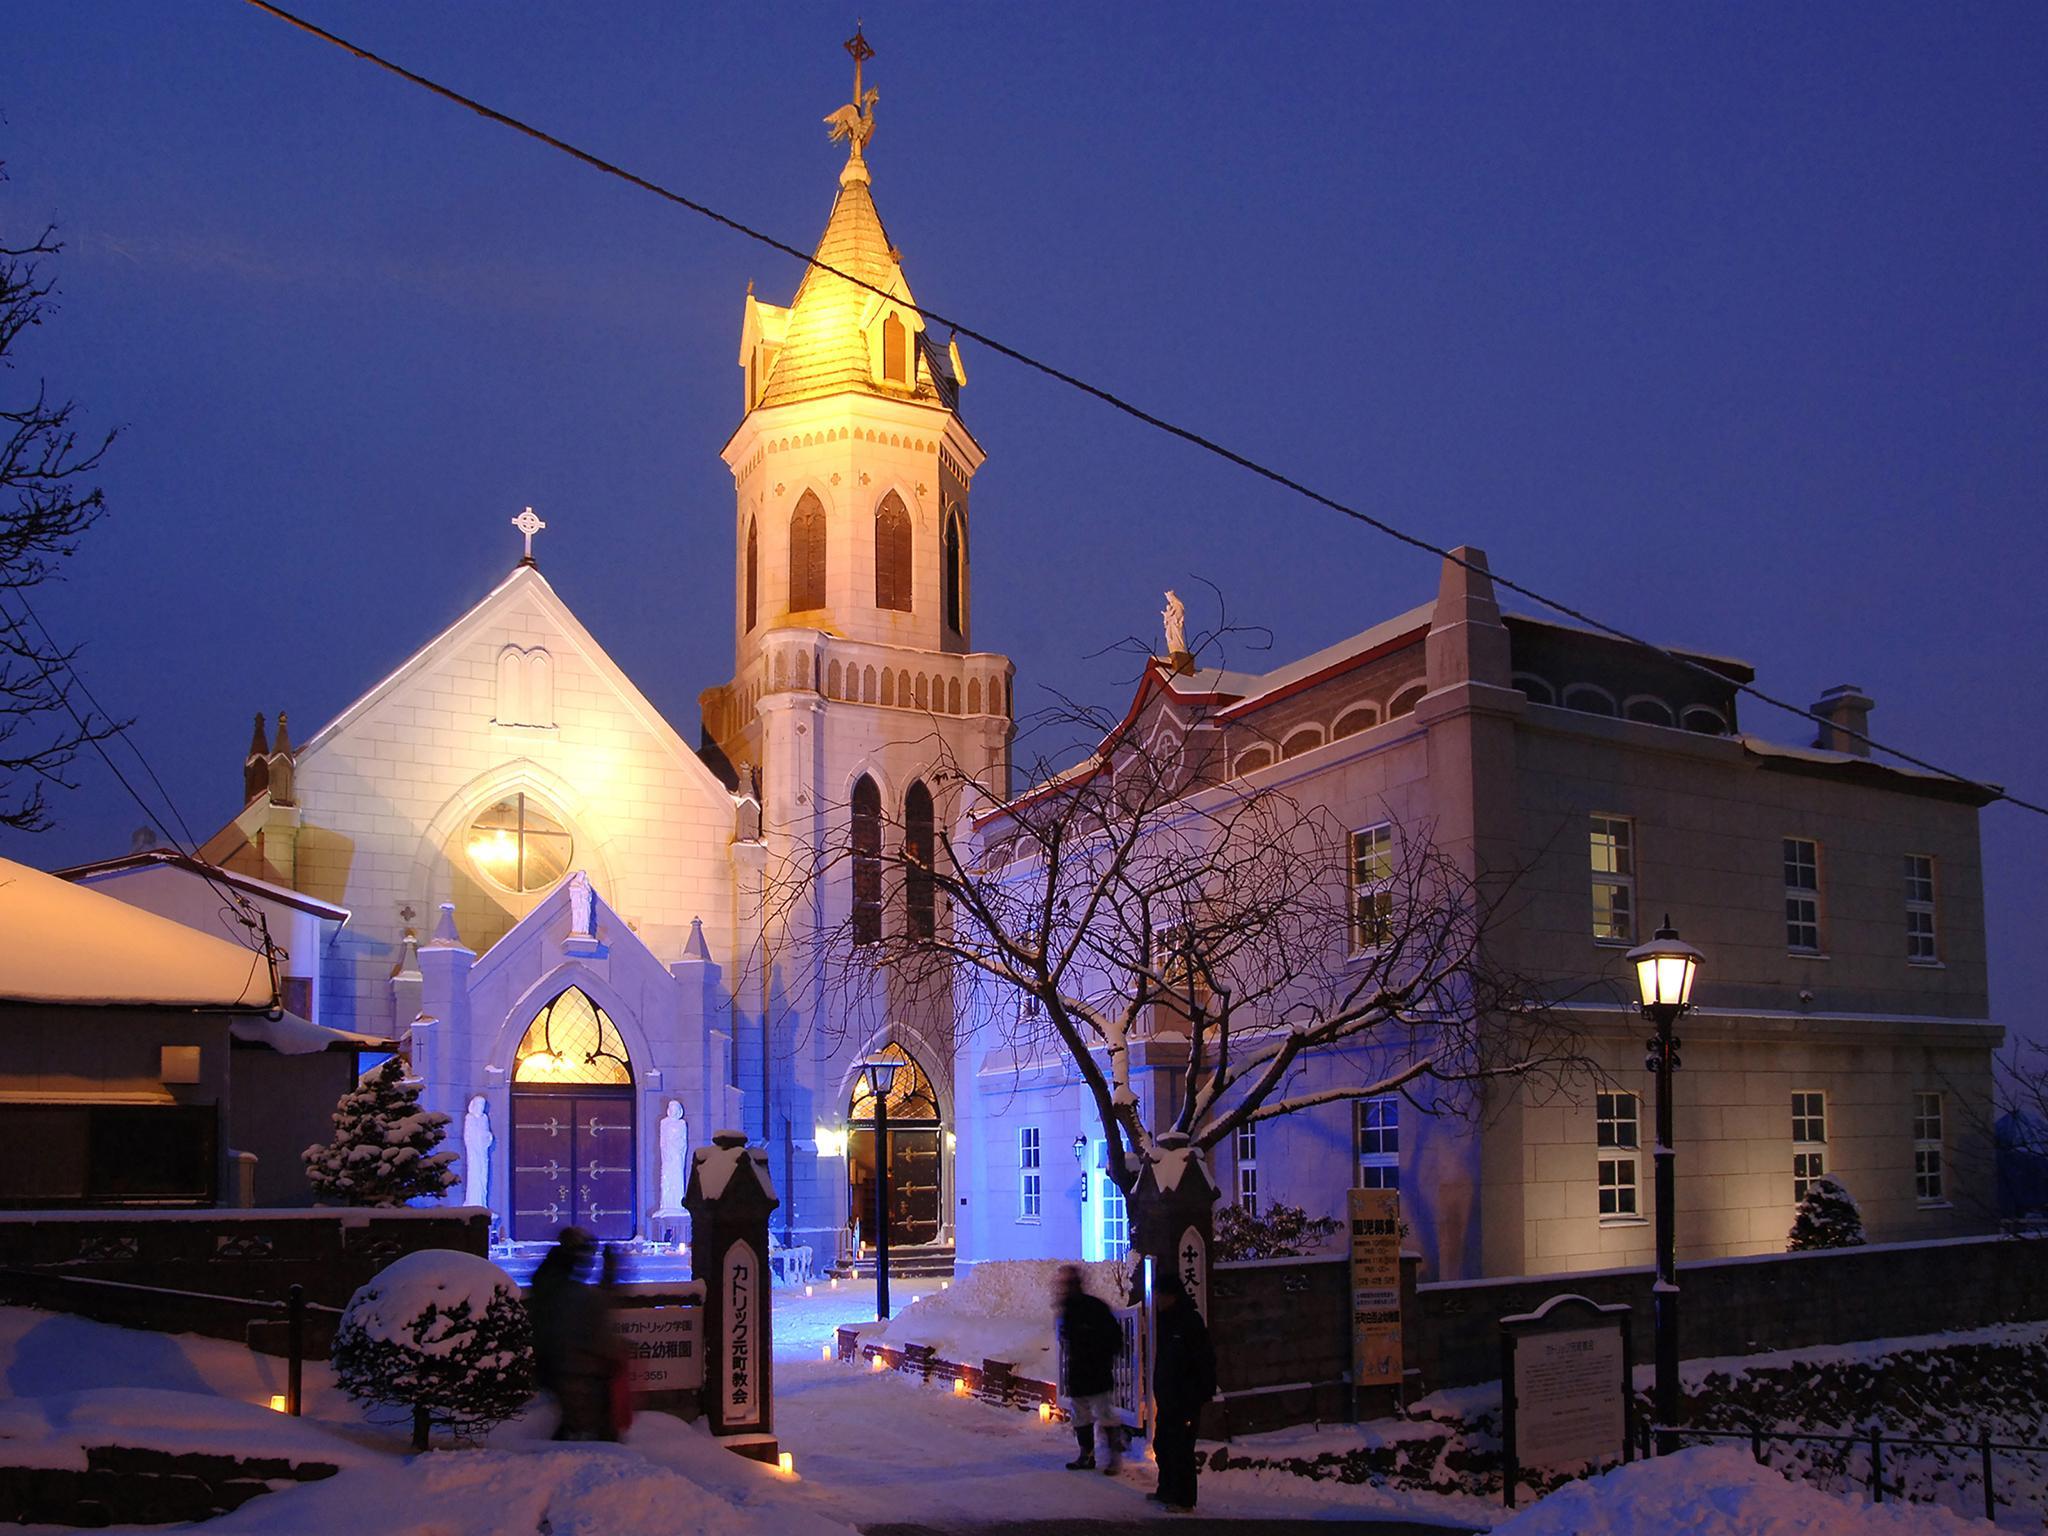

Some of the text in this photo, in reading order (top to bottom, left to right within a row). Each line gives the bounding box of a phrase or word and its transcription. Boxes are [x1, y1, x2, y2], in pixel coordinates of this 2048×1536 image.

[732, 1264, 749, 1404] カトリック元町教会
